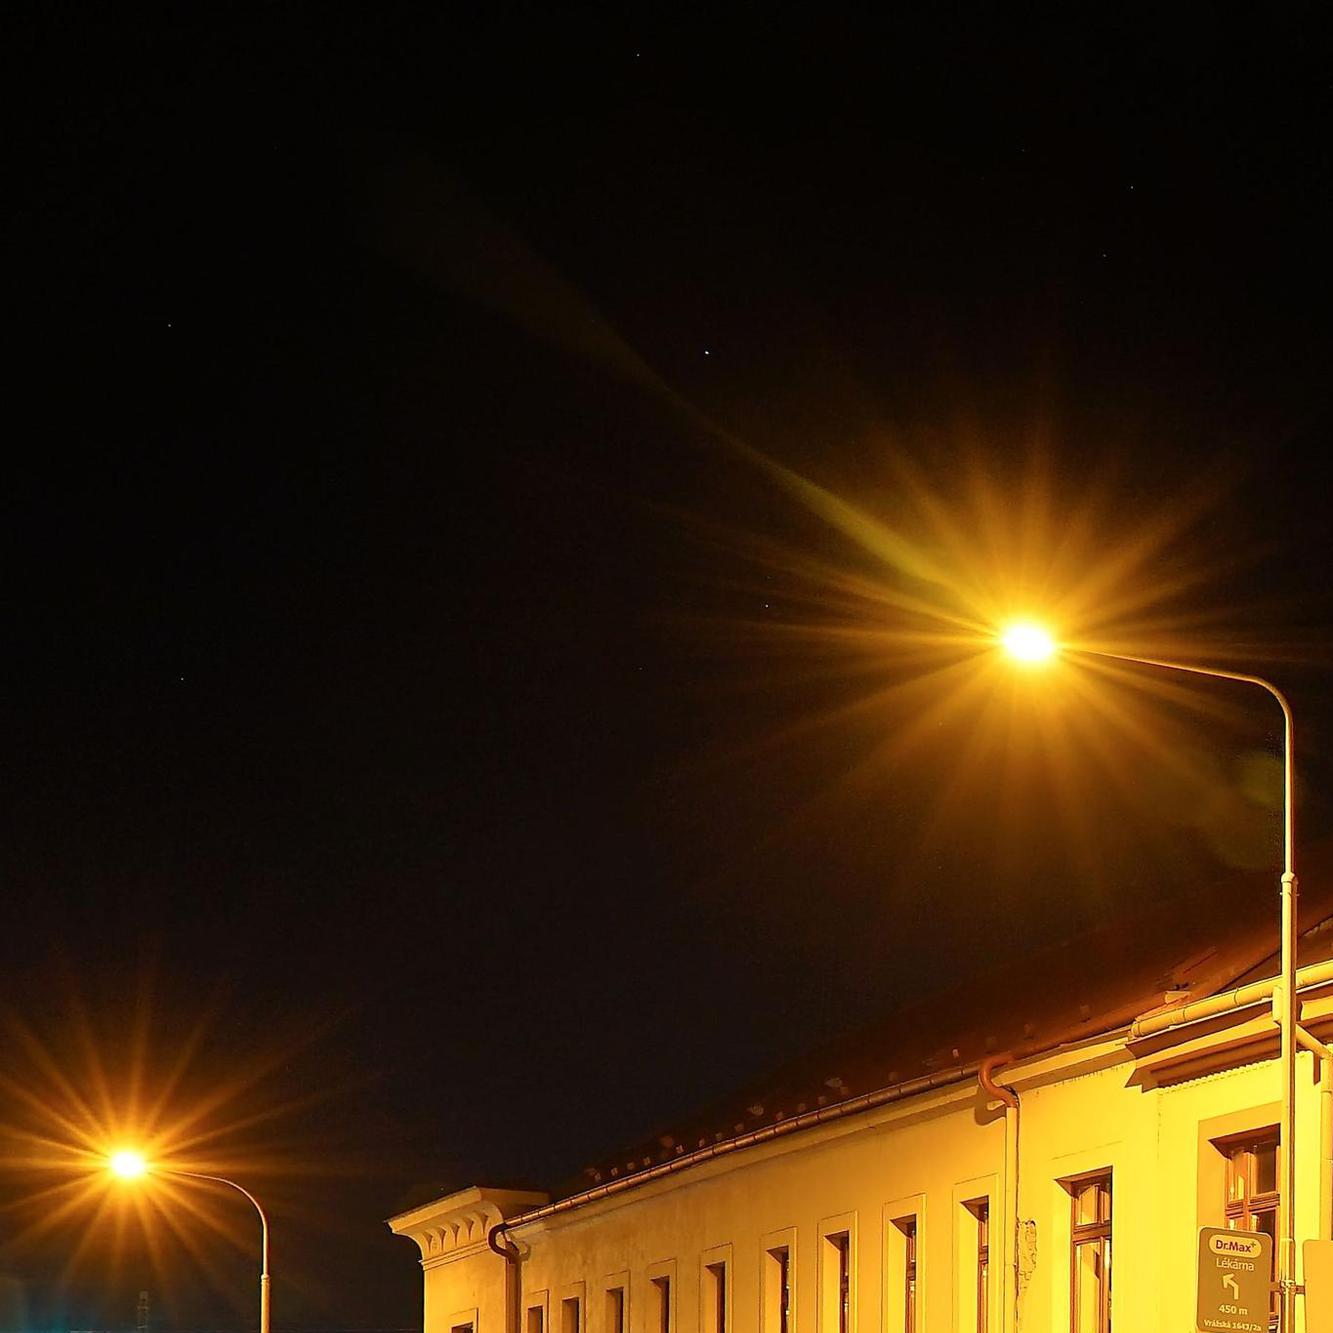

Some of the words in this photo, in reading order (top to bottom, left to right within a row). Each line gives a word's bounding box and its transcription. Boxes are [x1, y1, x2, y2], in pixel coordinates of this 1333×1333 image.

[1216, 1257, 1255, 1271] Lékárna
[1218, 1304, 1237, 1315] 450
[1238, 1307, 1248, 1315] m
